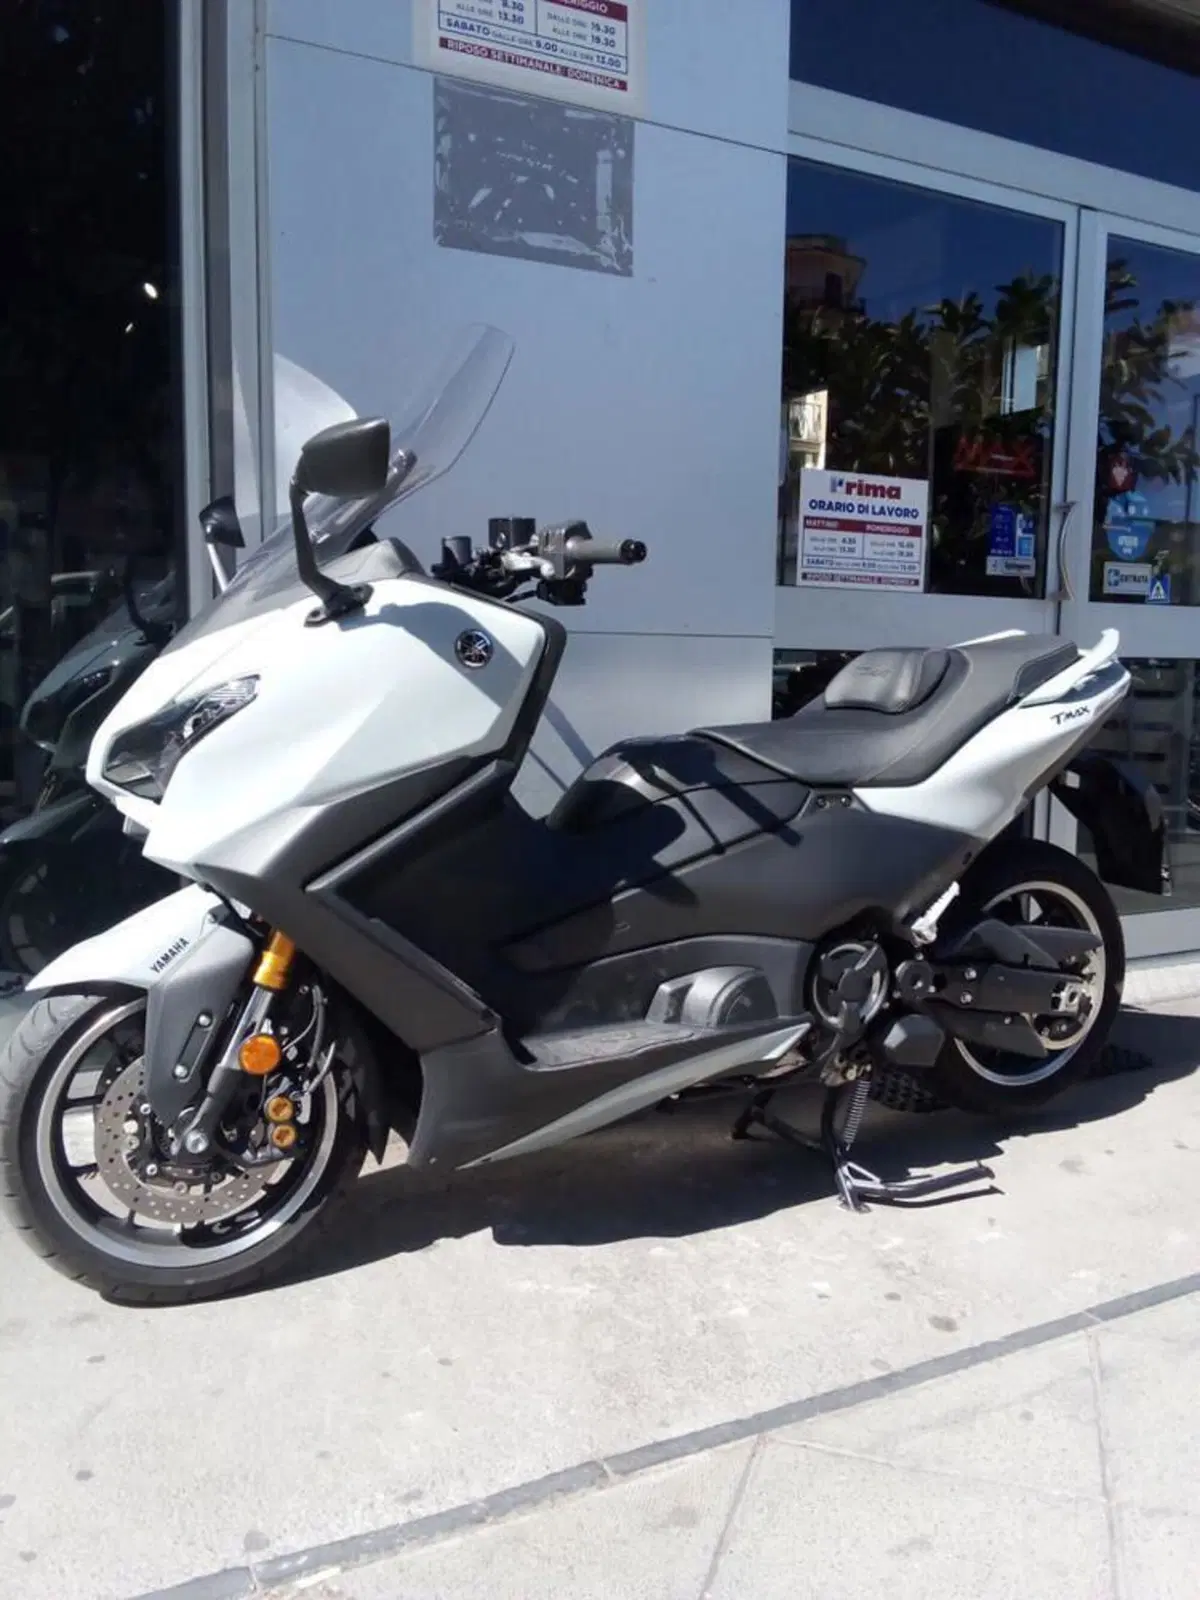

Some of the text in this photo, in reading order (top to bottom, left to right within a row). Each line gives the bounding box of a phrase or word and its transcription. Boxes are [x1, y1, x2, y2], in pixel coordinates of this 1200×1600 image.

[446, 17, 491, 37] SABATO
[447, 39, 490, 58] RIPOSO
[567, 68, 621, 88] DOMENICA
[809, 499, 920, 519] ORARIO DI LAVORO
[149, 937, 190, 973] YAMAHA
